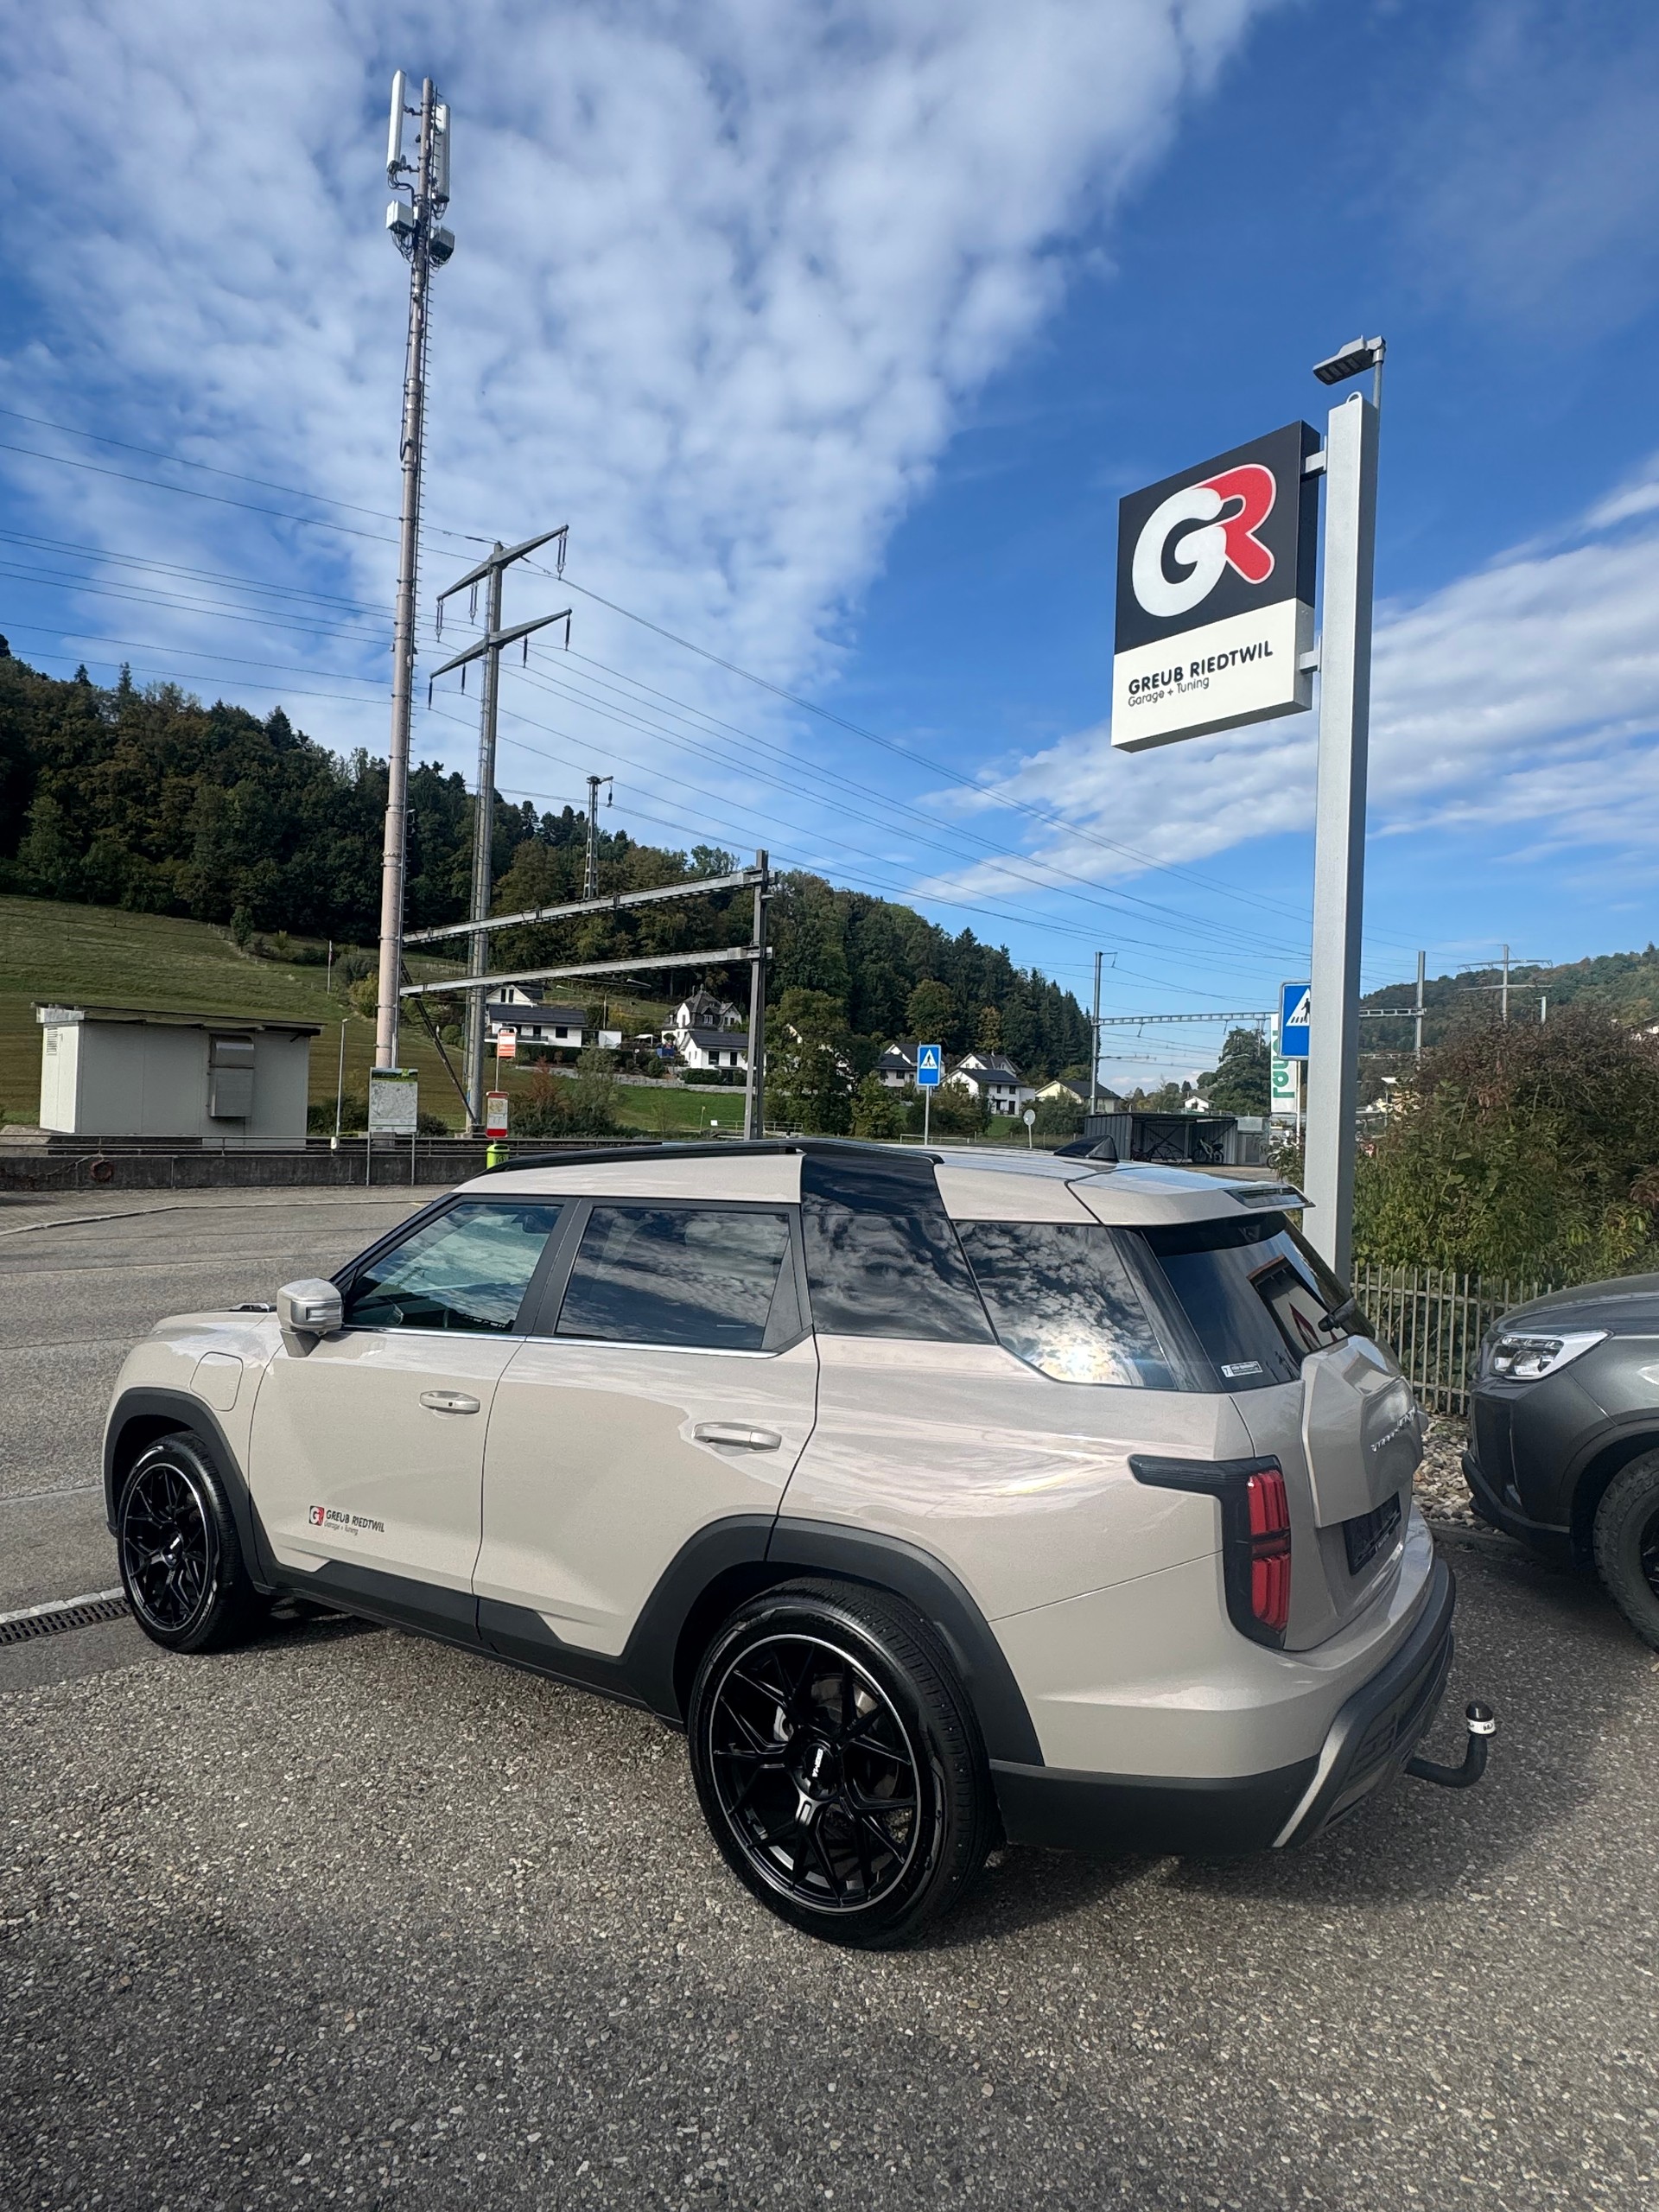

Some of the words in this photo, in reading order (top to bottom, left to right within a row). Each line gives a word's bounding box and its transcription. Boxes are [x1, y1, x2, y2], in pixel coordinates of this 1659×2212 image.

[1132, 463, 1277, 617] GR
[1128, 666, 1184, 695] GREUB
[1190, 640, 1273, 678] RIEDTWIL
[1128, 690, 1165, 707] Garage
[1167, 688, 1174, 696] +
[1177, 677, 1210, 694] Tuning
[326, 1510, 350, 1524] GREUB
[352, 1516, 385, 1533] RIEDTWIL
